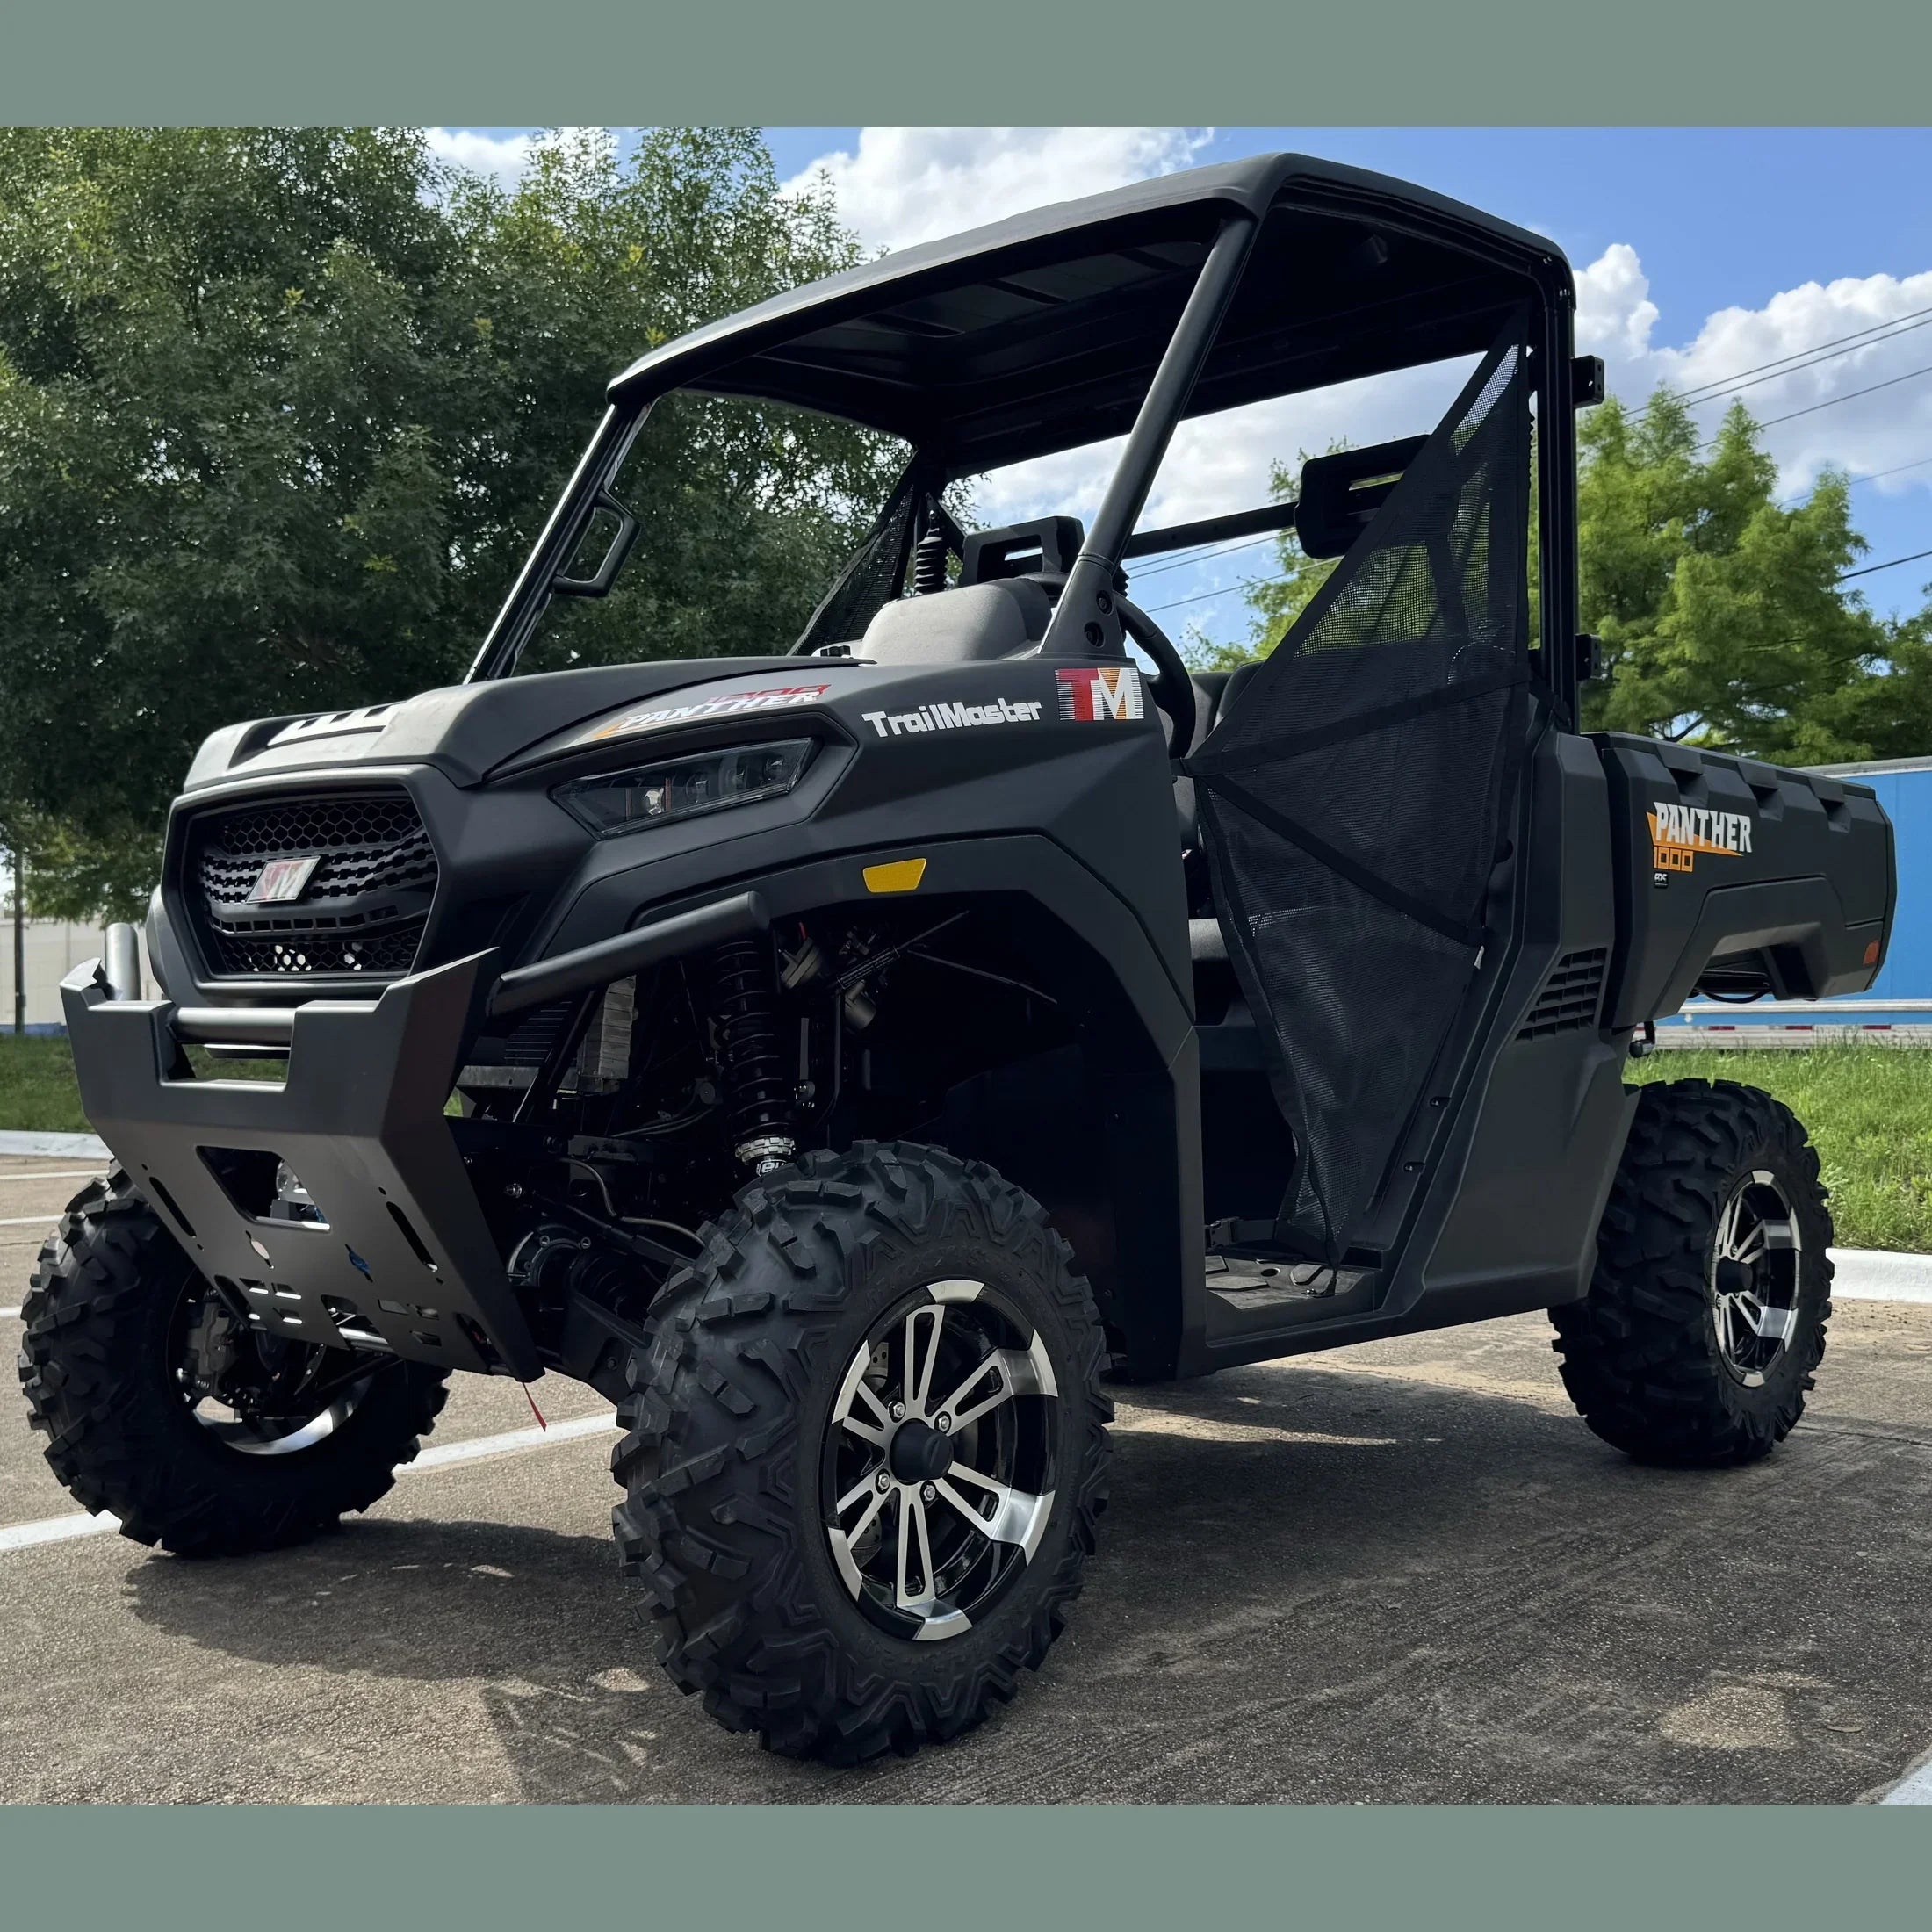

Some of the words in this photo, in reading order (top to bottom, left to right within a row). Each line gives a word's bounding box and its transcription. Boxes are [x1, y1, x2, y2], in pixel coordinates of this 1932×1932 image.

[618, 690, 822, 729] PANTHER
[1056, 667, 1144, 721] TM
[861, 698, 1042, 737] TrailMaster
[1654, 801, 1753, 853] PANTHER
[1654, 846, 1694, 872] 1000
